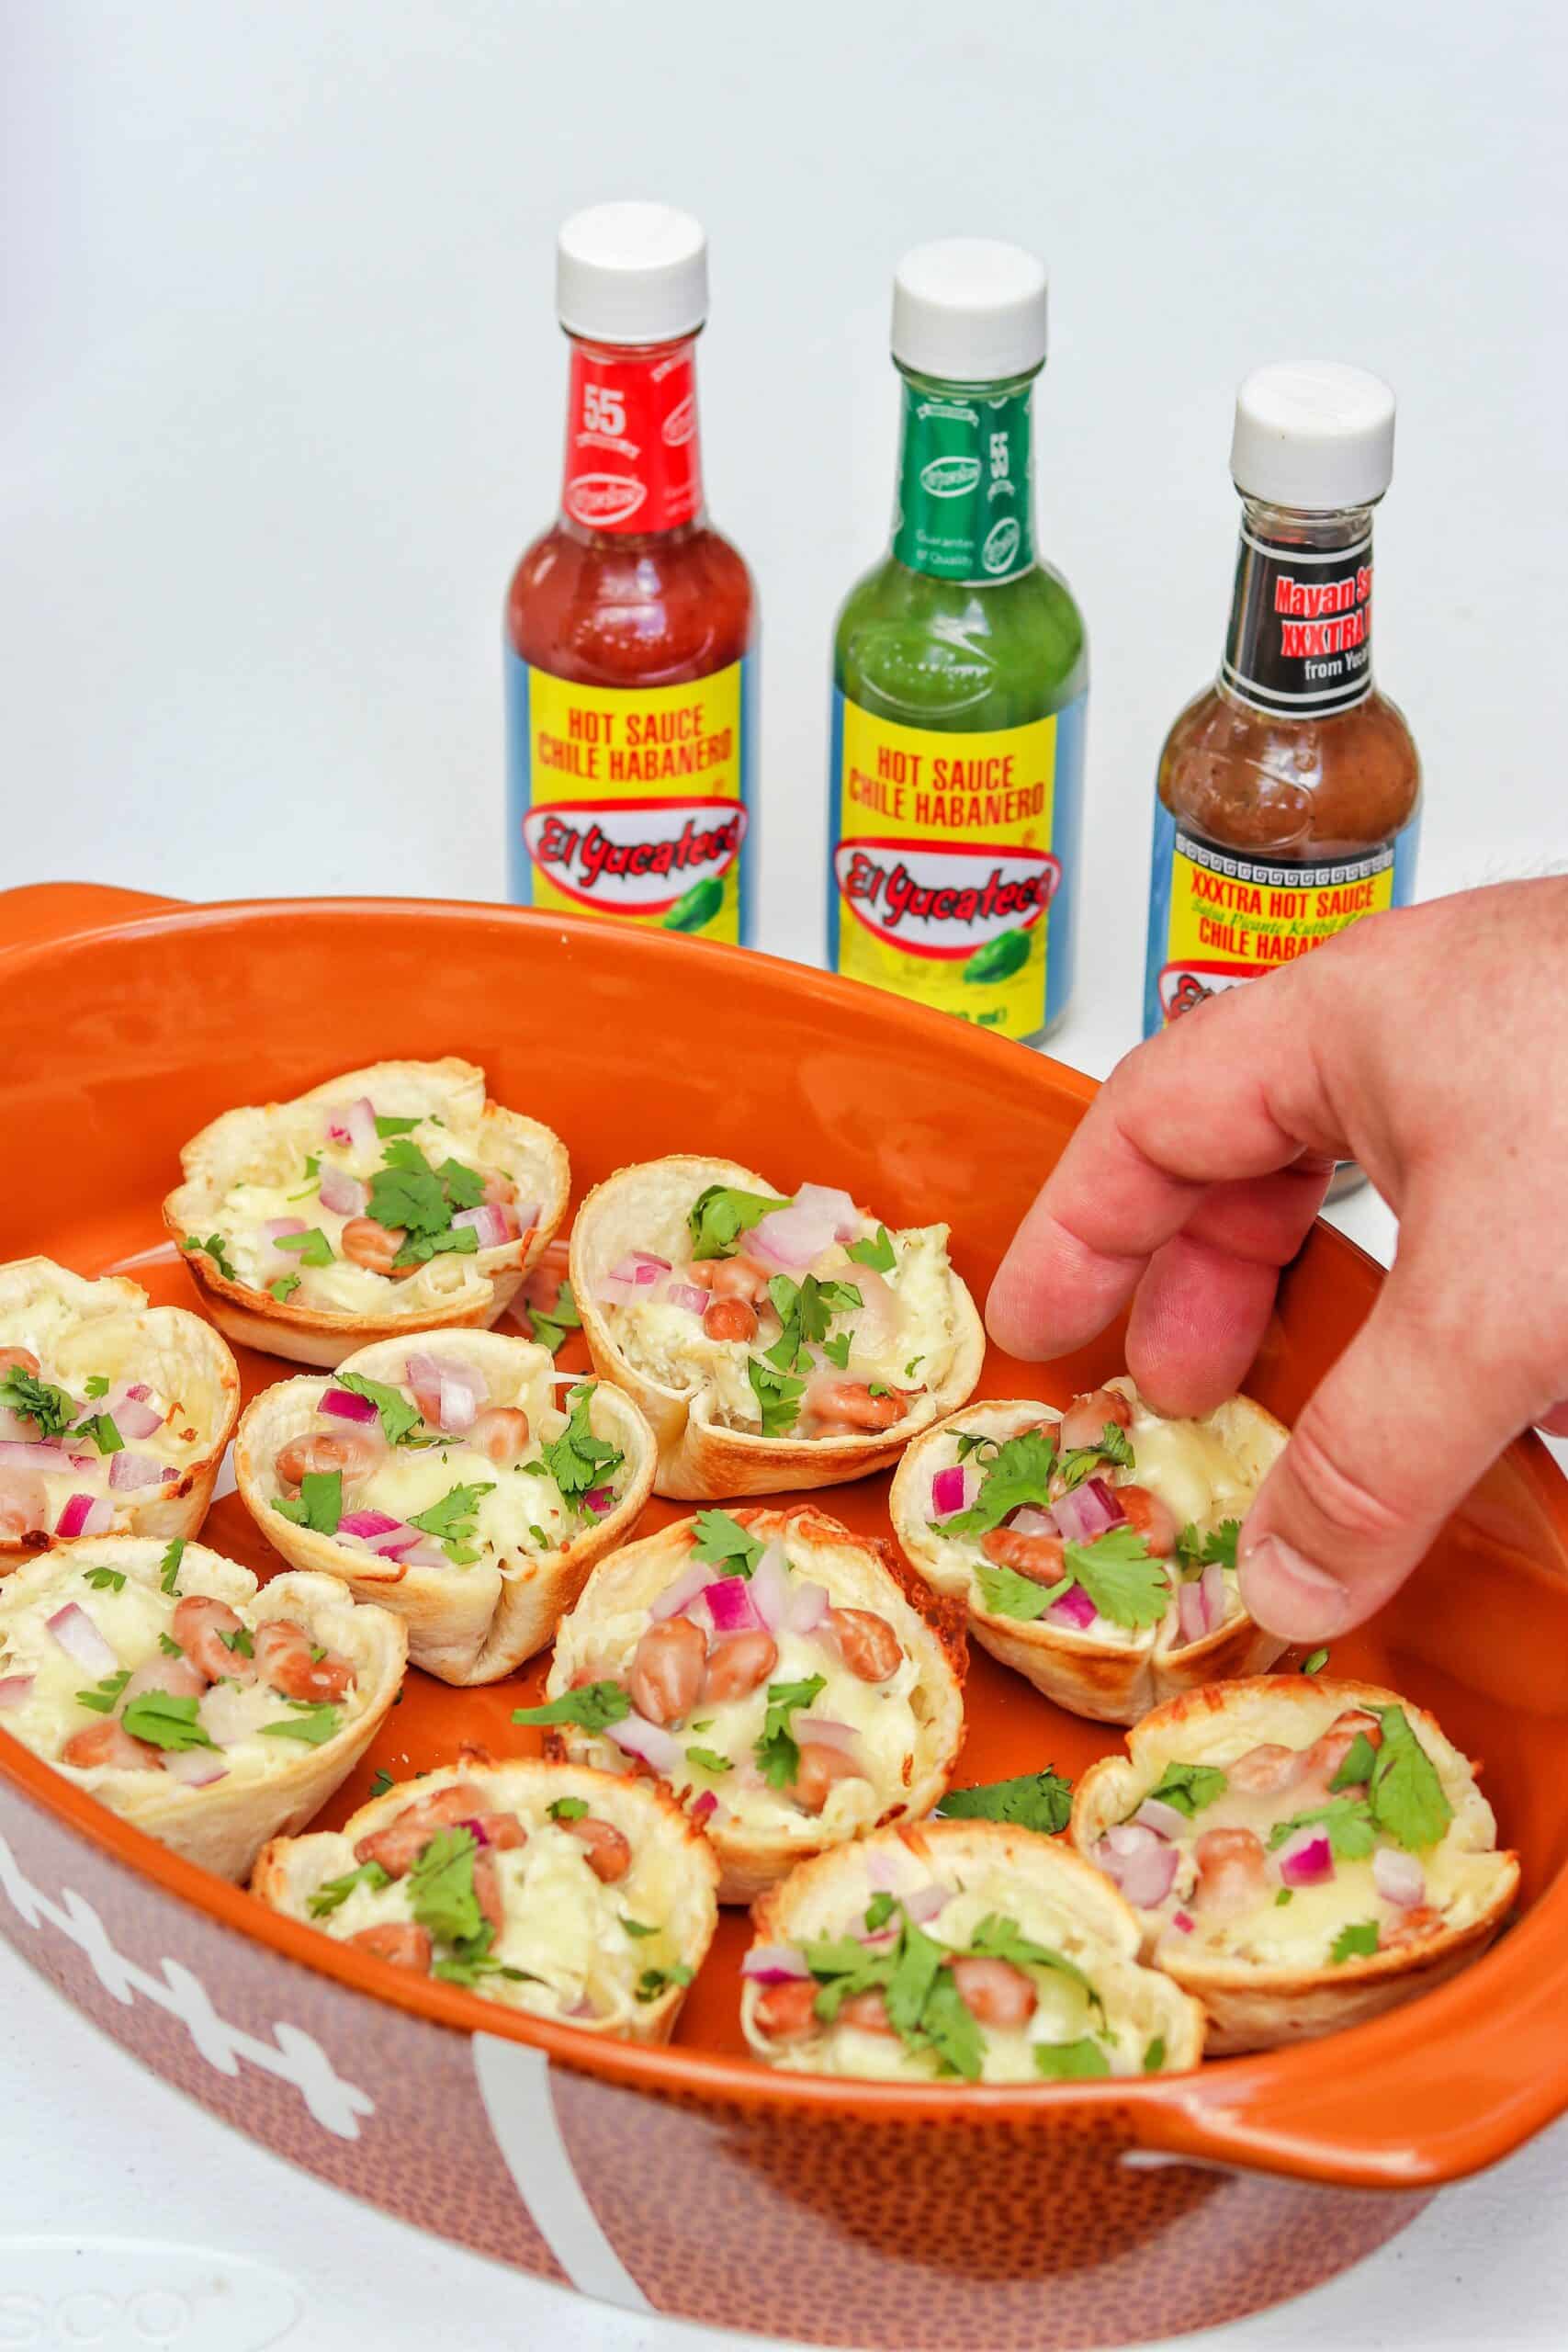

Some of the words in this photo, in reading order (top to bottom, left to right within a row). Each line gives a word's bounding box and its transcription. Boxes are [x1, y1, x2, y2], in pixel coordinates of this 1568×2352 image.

[583, 382, 626, 435] 55
[1275, 575, 1356, 618] Mayan
[1280, 607, 1365, 657] XXXTRA
[1304, 658, 1342, 681] from
[569, 706, 614, 746] HOT
[626, 702, 705, 746] SAUCE
[538, 730, 600, 780] CHILE
[610, 726, 732, 782] HABANERO
[877, 745, 922, 787] HOT
[933, 754, 1014, 792] SAUCE
[849, 767, 905, 820] CHILE
[915, 782, 1044, 828] HABANERO
[537, 815, 579, 868] El
[578, 813, 740, 888] Yucateco
[845, 852, 886, 907] El
[883, 860, 1054, 928] Yucateco
[1190, 867, 1261, 916] XXXTRA
[1269, 890, 1311, 920] HOT
[1316, 880, 1374, 919] SAUCE
[1199, 916, 1249, 956] CHILE
